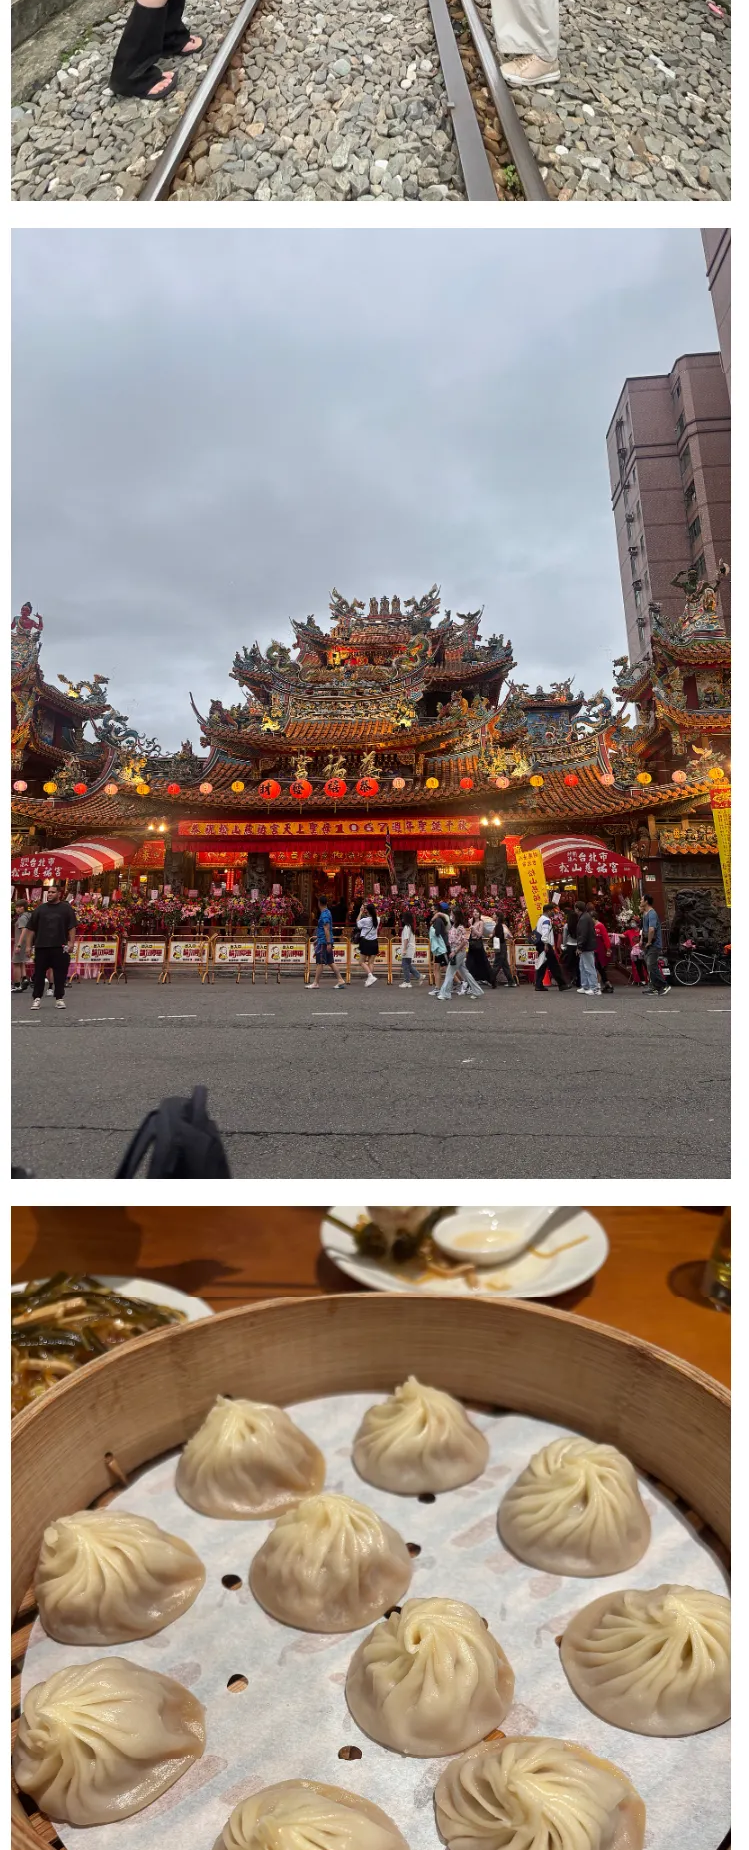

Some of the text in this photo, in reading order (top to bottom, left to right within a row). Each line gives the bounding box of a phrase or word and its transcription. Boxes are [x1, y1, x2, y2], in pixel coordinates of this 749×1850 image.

[29, 857, 56, 868] 台北市
[578, 851, 608, 863] 台北市
[559, 861, 619, 874] 松山慈祐宮
